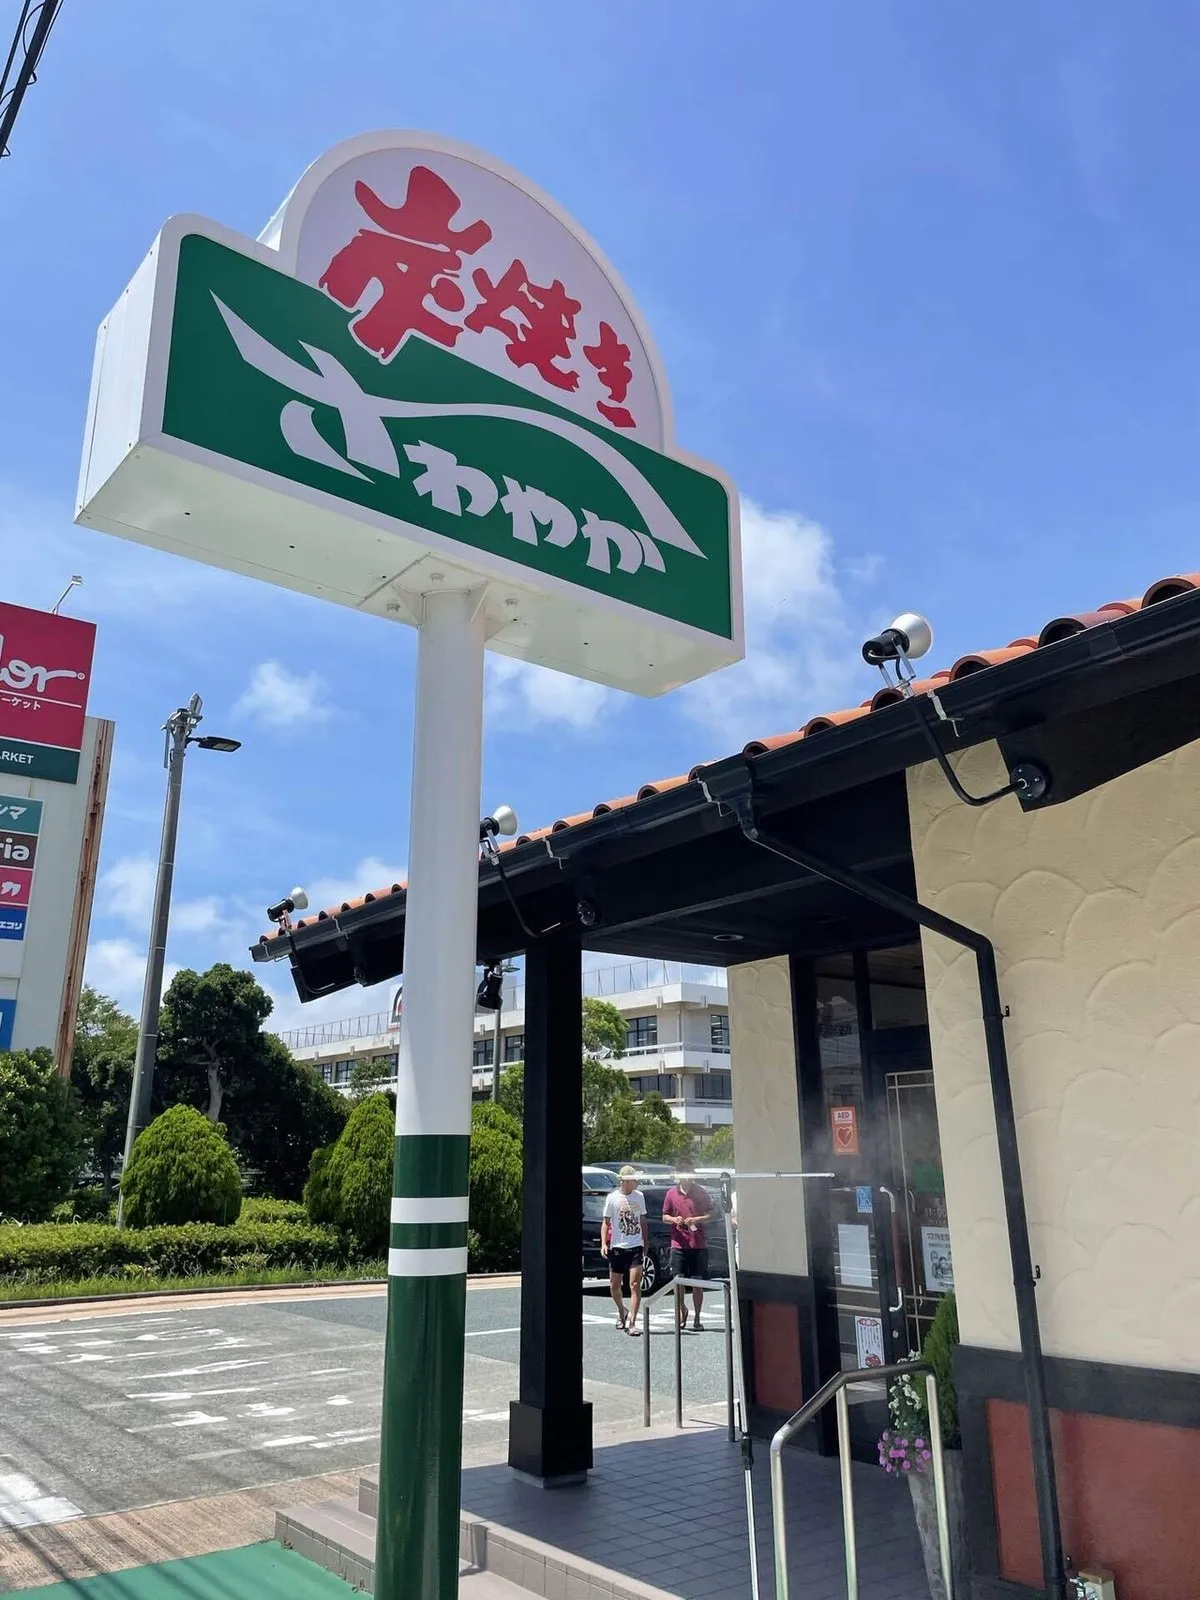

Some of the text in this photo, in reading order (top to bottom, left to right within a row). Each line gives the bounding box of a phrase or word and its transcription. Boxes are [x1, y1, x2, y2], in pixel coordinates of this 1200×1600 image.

[319, 165, 637, 428] 炭焼き
[209, 288, 708, 574] さわやか
[0, 750, 35, 765] RKET
[837, 1111, 850, 1119] AED
